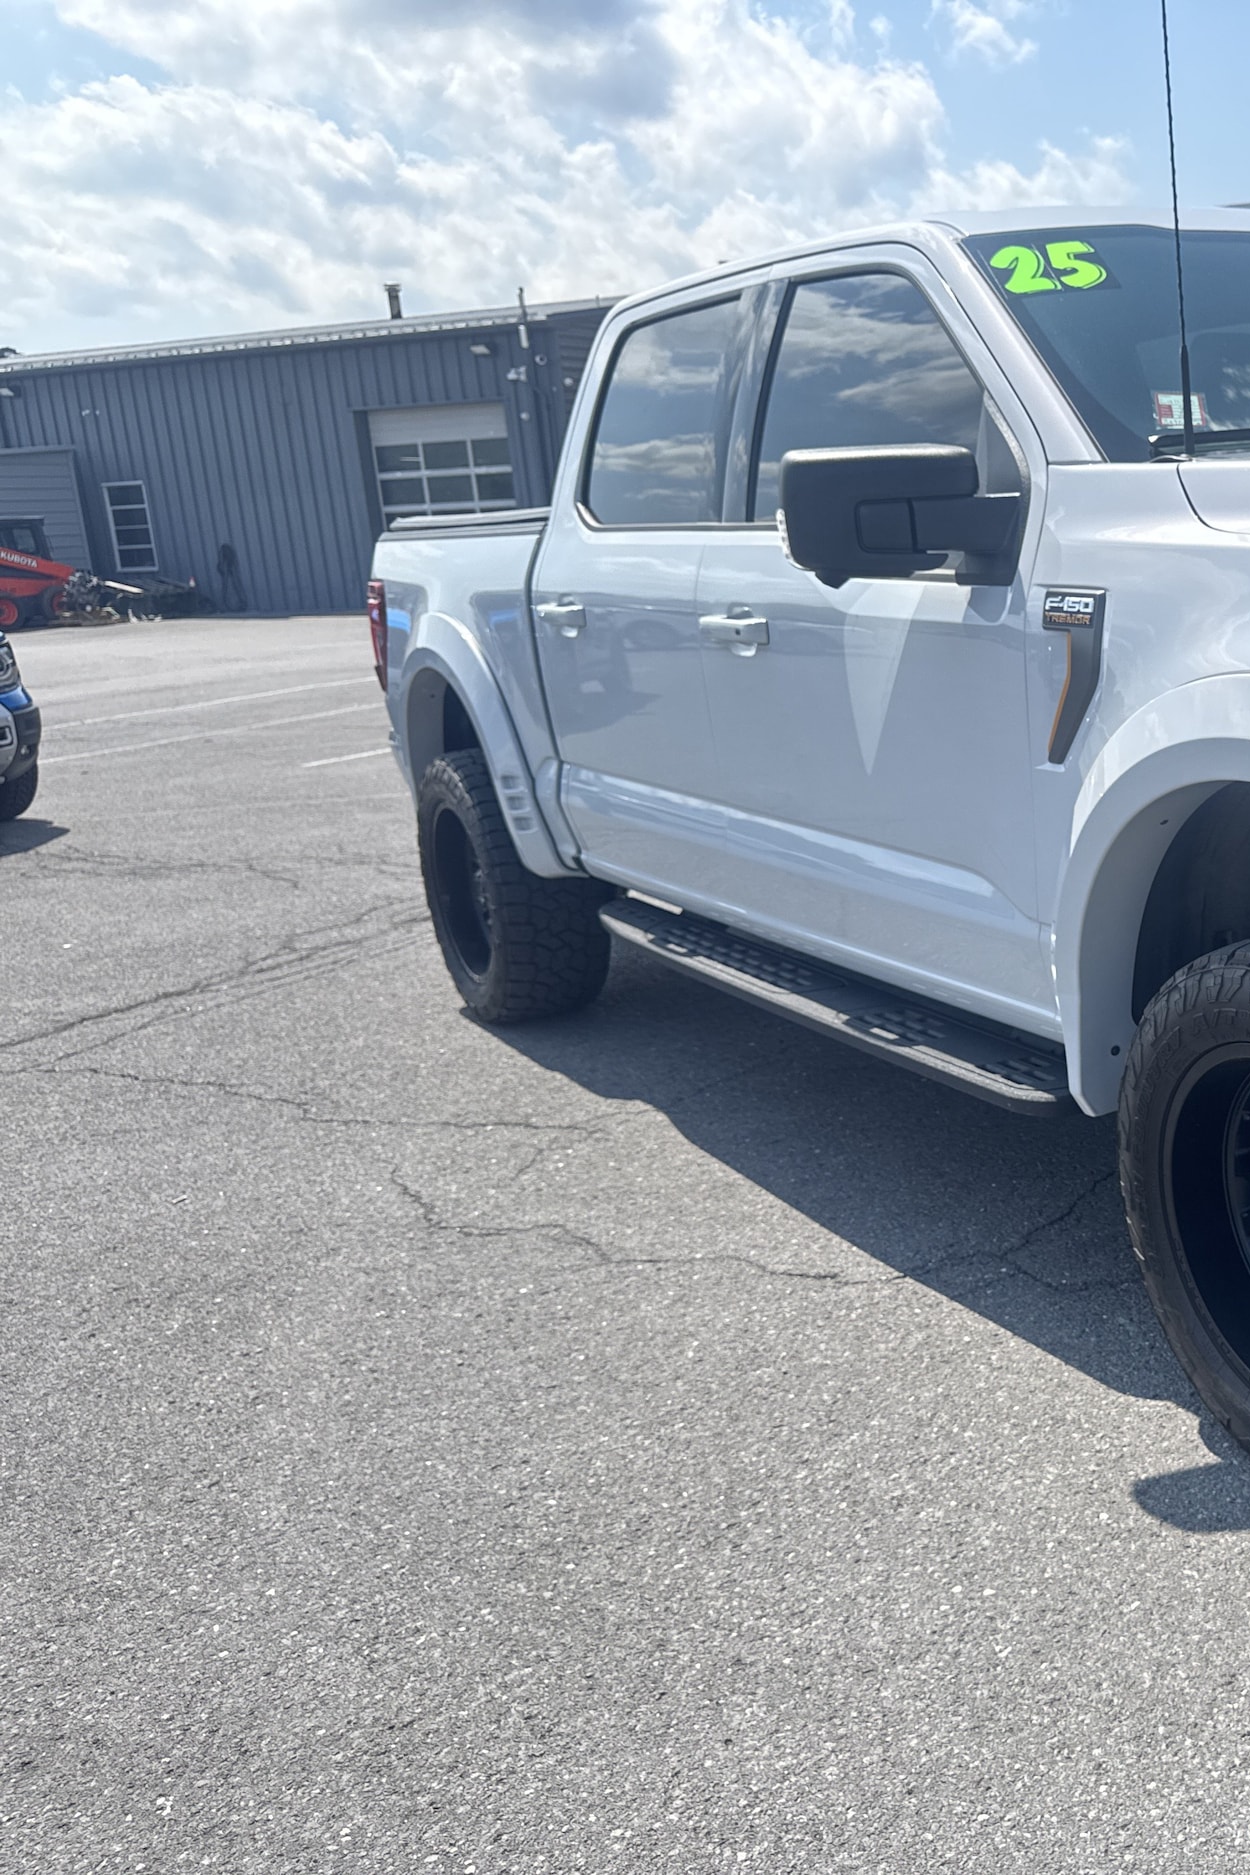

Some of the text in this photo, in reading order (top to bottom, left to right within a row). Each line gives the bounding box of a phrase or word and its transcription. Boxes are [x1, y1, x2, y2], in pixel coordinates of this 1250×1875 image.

[990, 240, 1107, 294] 25
[0, 551, 38, 568] KUBOTA
[1045, 596, 1094, 613] F-150
[1045, 611, 1091, 625] TREMOR
